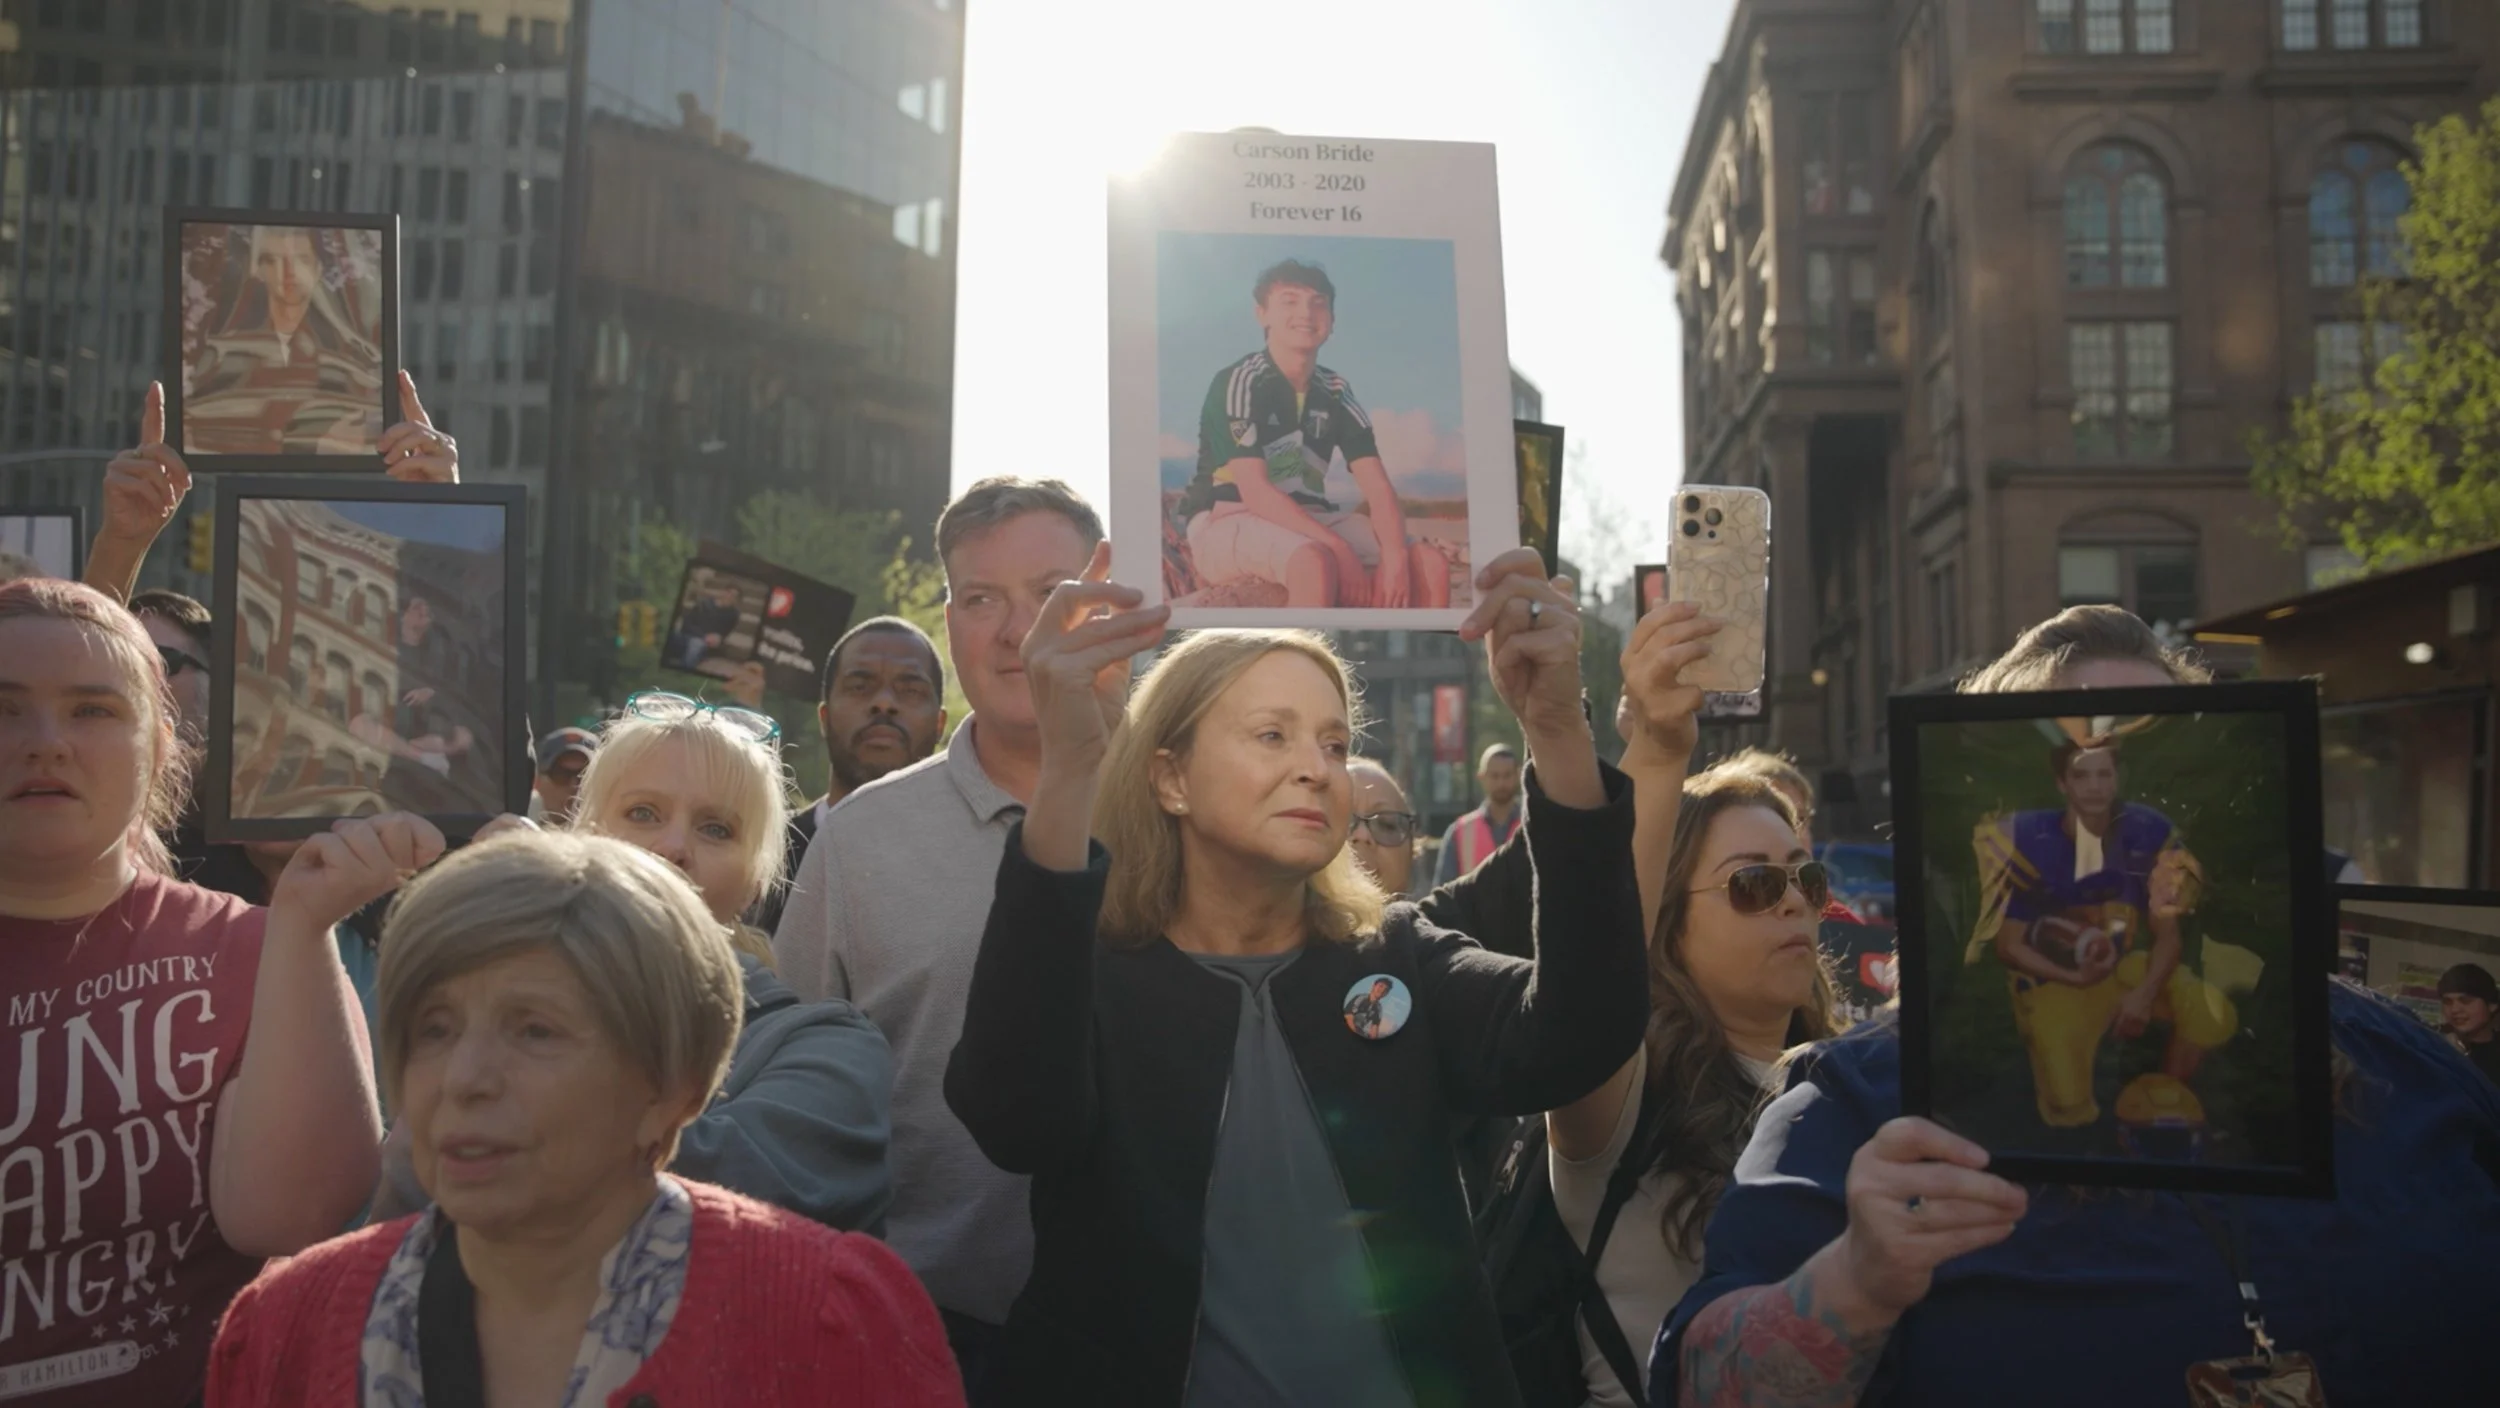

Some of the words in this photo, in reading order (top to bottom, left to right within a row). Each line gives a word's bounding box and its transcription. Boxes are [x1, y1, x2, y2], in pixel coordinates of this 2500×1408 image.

[1233, 140, 1309, 160] Carson
[1316, 143, 1374, 162] Bride
[1244, 171, 1295, 190] 2003
[1315, 173, 1365, 192] 2020
[1251, 201, 1335, 221] Forever
[1341, 205, 1362, 222] 16
[7, 988, 61, 1026] MY
[75, 952, 218, 1006] COUNTRY
[20, 1350, 109, 1387] HAMILTON
